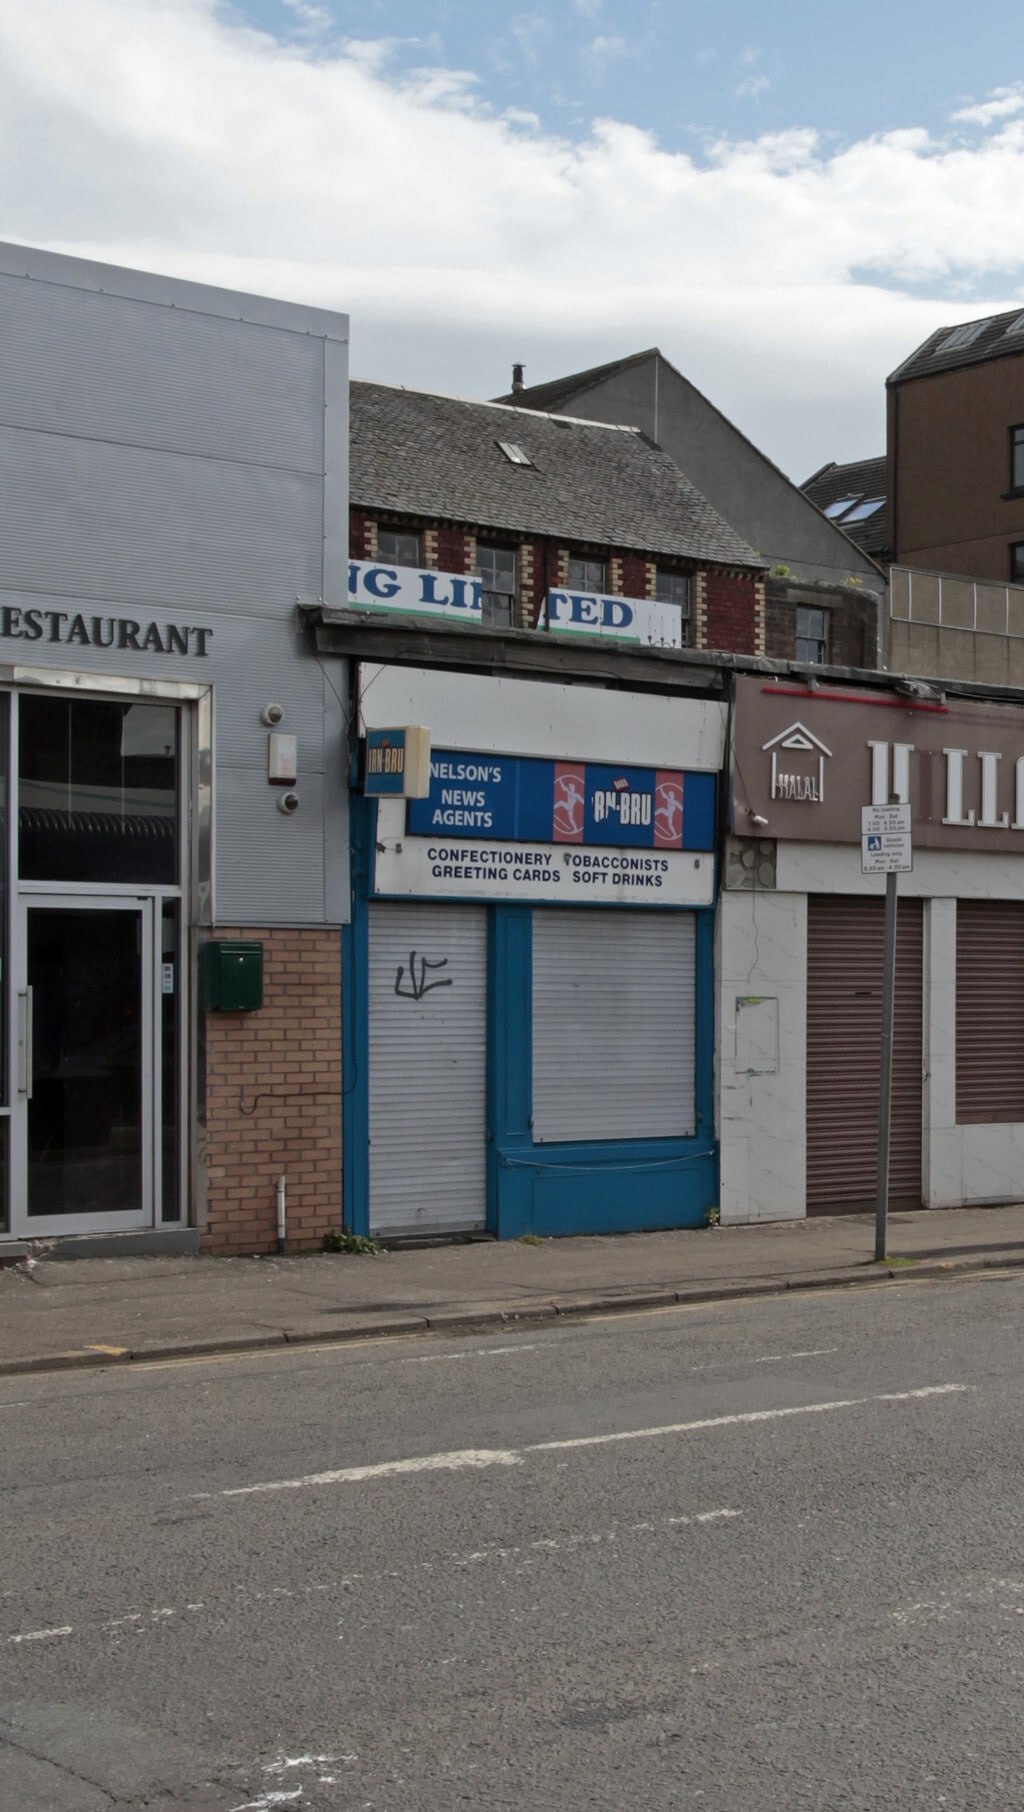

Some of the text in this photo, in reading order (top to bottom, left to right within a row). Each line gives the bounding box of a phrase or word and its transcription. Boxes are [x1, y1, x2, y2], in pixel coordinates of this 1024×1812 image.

[1, 606, 213, 657] ESTAURANT
[429, 762, 502, 783] NELSON'S
[441, 789, 485, 807] NEWS
[432, 809, 493, 828] AGENTS
[427, 848, 552, 866] CONFECTIONERY
[432, 865, 561, 882] GREETING CARDS
[572, 871, 663, 887] SOFT DRINKS
